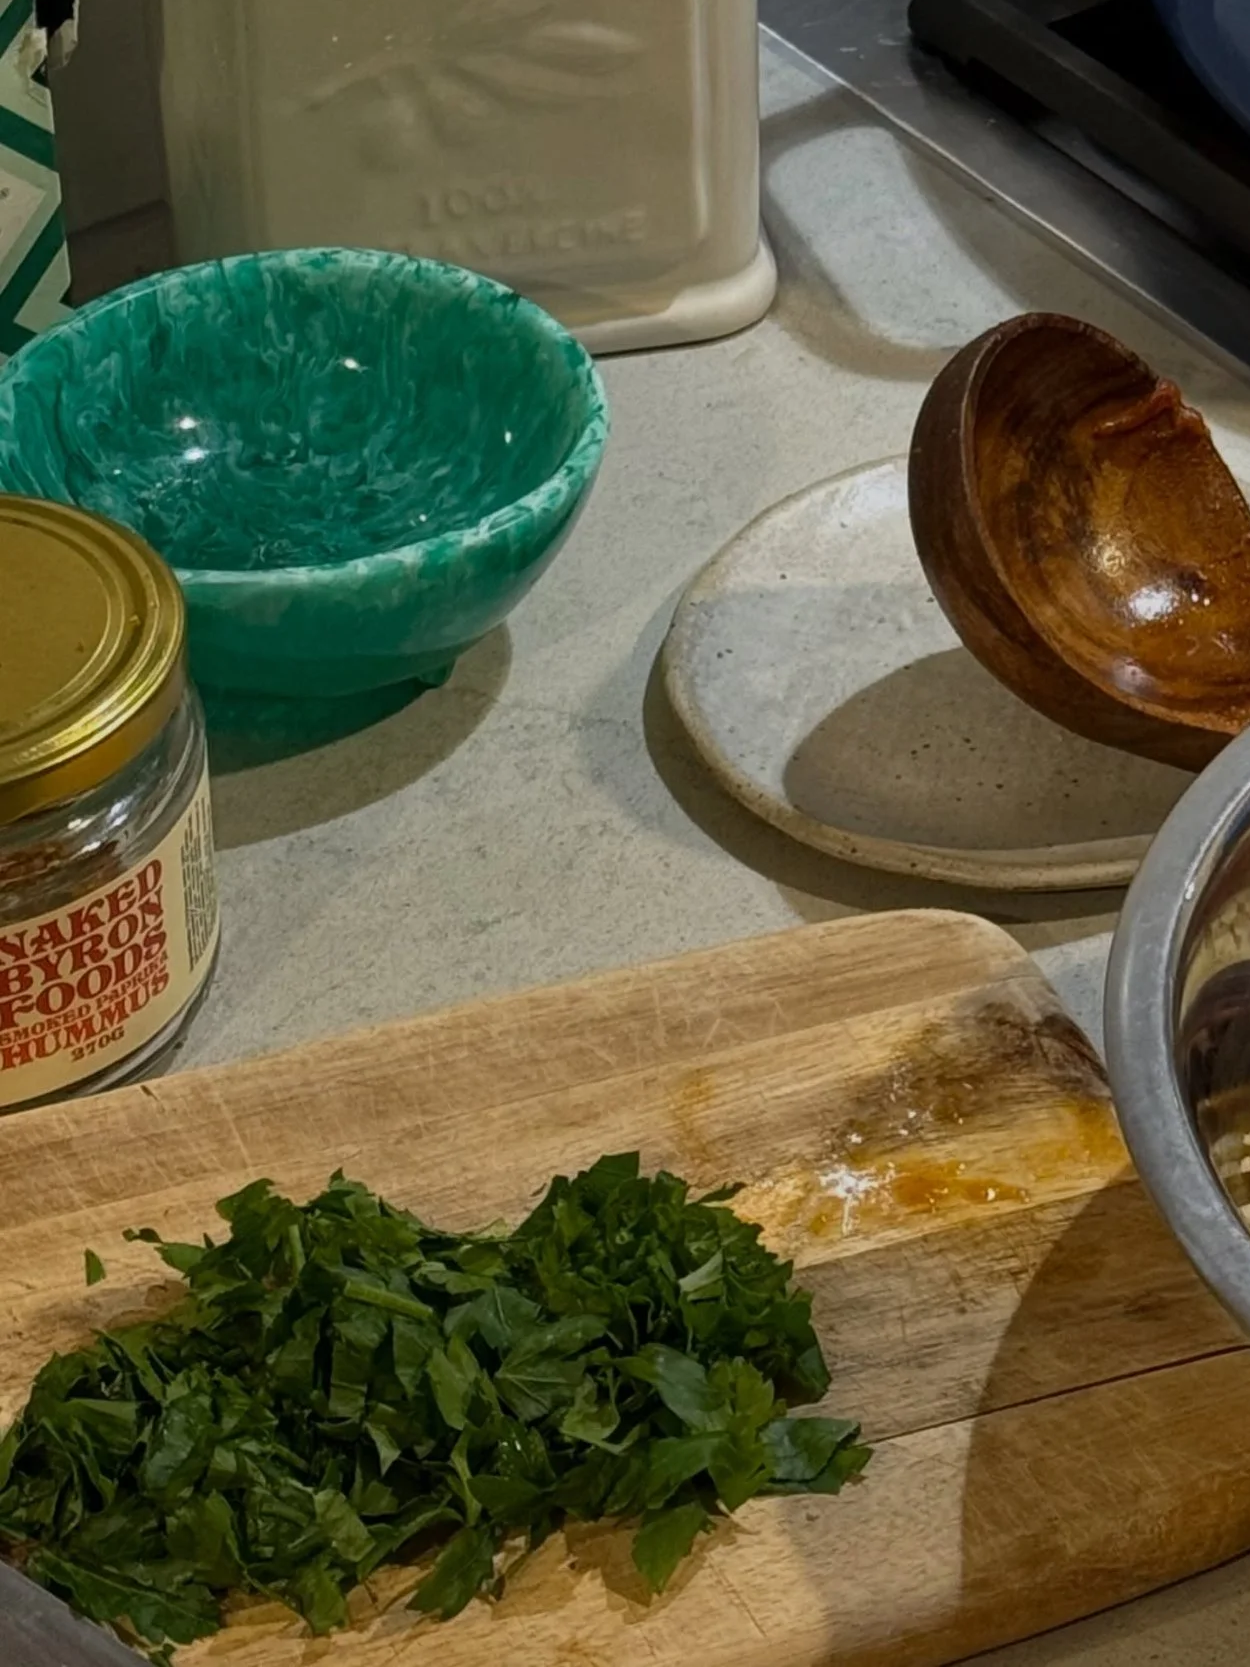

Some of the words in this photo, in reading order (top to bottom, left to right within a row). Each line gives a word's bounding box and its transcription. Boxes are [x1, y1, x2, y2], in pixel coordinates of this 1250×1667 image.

[0, 859, 163, 966] NAKED
[0, 885, 164, 997] BYRON
[0, 919, 167, 1031] FOODS
[0, 972, 169, 1071] HUMMUS
[0, 1003, 91, 1047] SMOKED
[71, 1026, 125, 1063] 270G
